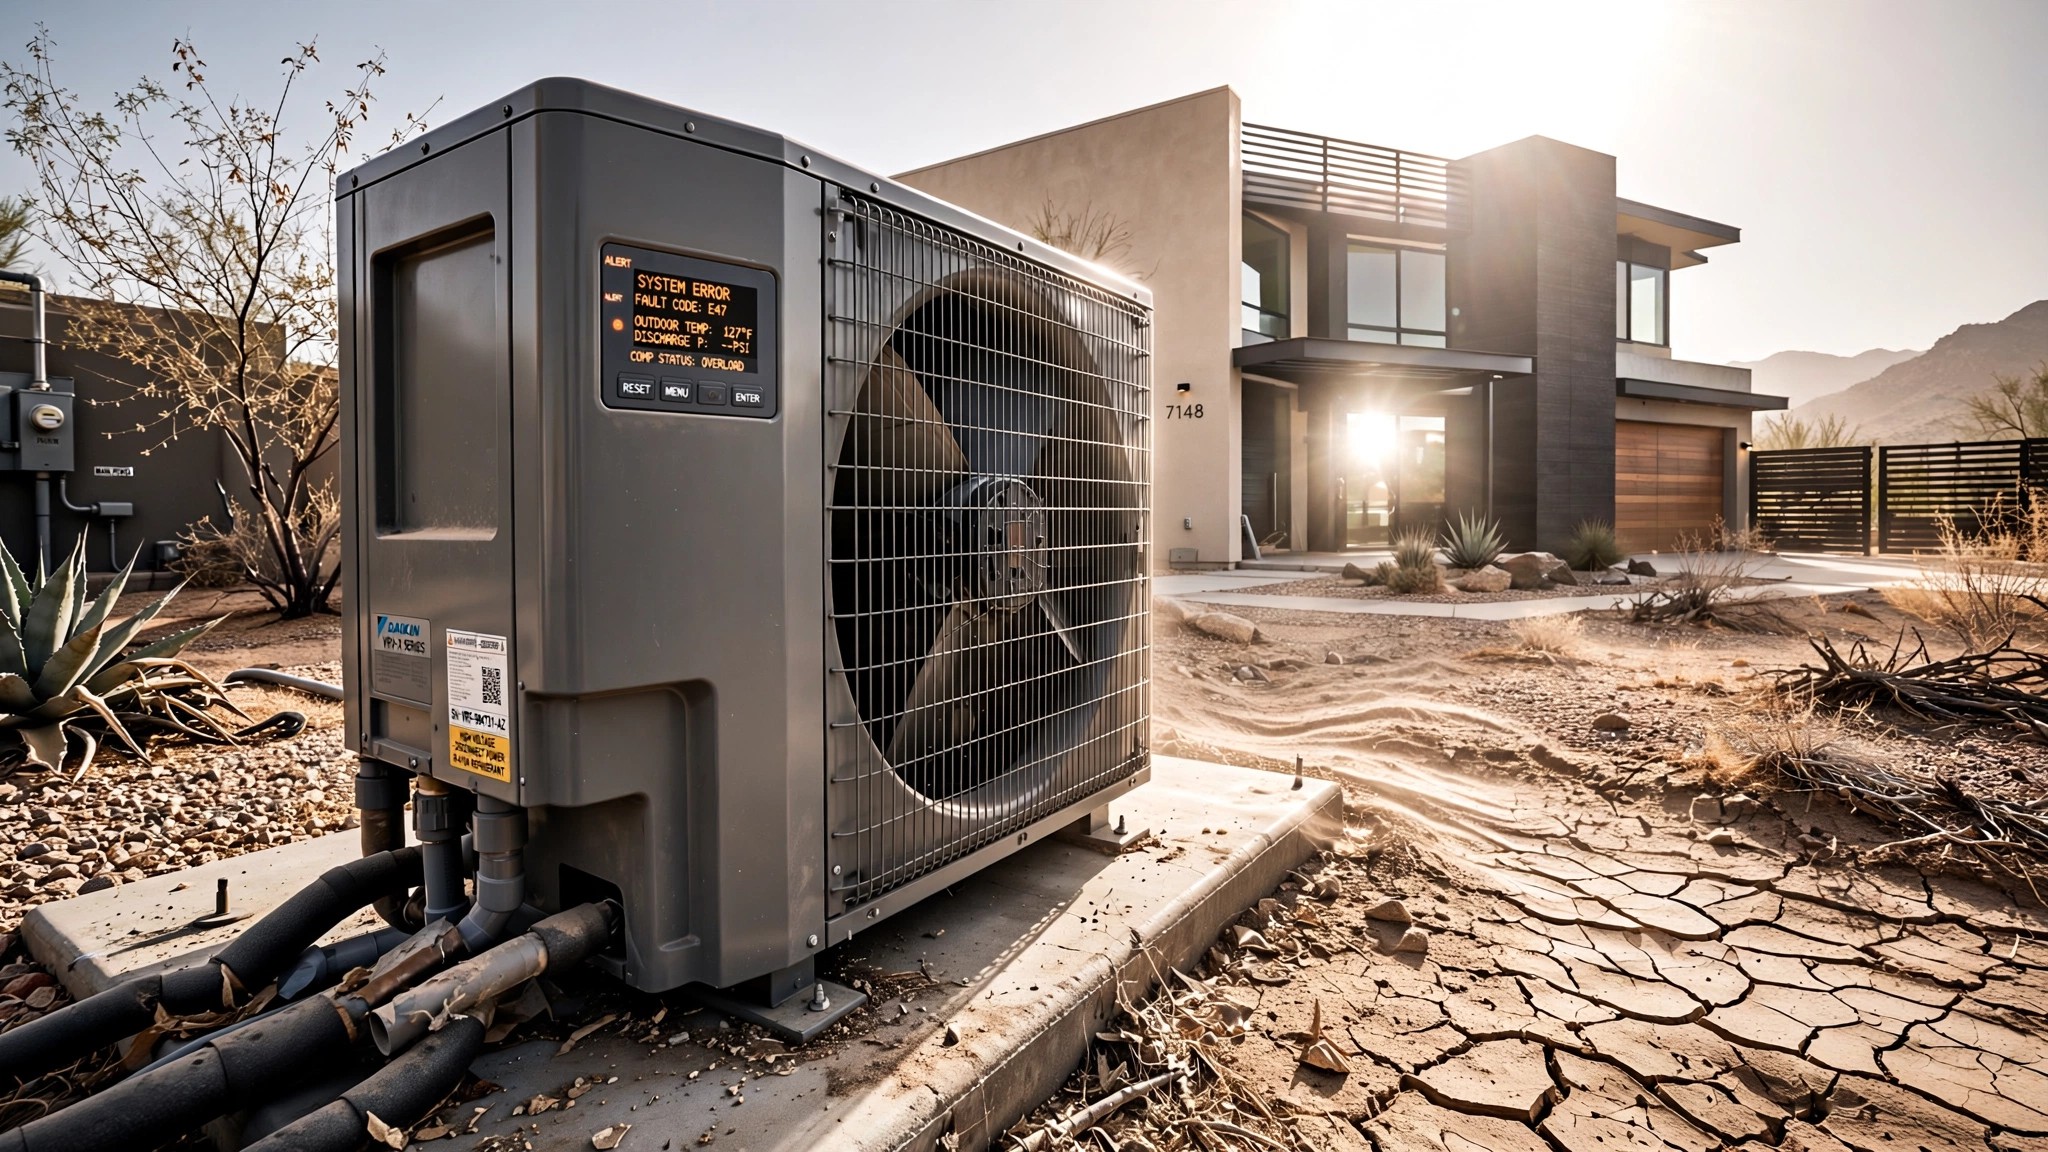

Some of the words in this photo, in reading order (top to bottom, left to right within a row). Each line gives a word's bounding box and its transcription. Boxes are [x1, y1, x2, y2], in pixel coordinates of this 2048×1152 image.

[604, 255, 632, 268] ALERT
[637, 274, 686, 294] SYSTEM
[693, 282, 731, 301] ERROR
[604, 293, 623, 302] ALERT
[635, 293, 667, 309] FAULT
[672, 299, 702, 313] CODE:
[708, 303, 727, 316] E47
[634, 315, 679, 331] OUTDOOR
[685, 321, 713, 335] TEMP:
[723, 326, 752, 341] 127°F
[634, 330, 690, 348] DISCHARGE
[697, 337, 708, 348] P:
[630, 350, 654, 363] COMP
[658, 353, 695, 367] STATUS:
[701, 357, 744, 372] OVERLOAD
[623, 382, 651, 395] RESET
[665, 386, 689, 398] MENU
[735, 393, 760, 403] ENTER
[1165, 403, 1204, 419] 7148
[388, 622, 420, 636] DAIKIN
[485, 748, 506, 764] POWER
